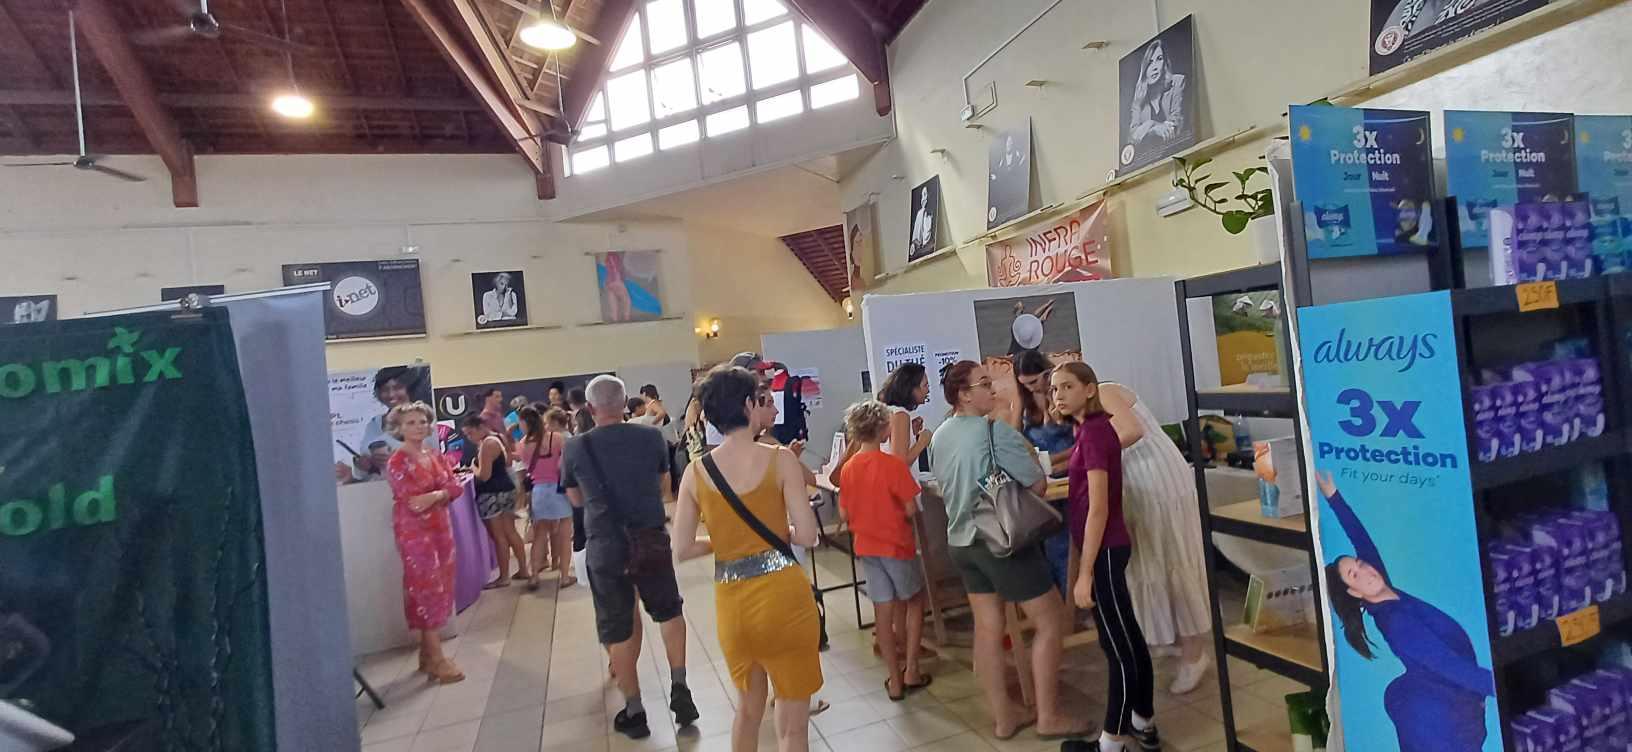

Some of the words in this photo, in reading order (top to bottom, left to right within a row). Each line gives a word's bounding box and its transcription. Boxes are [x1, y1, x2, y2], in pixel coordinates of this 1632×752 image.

[1352, 125, 1379, 149] 3x
[1501, 128, 1525, 149] 3x
[1330, 148, 1401, 166] Protection
[1480, 148, 1546, 163] Protection
[1027, 219, 1081, 257] INFRA
[1028, 240, 1099, 280] ROUGE
[1313, 326, 1438, 373] always
[445, 395, 466, 415] U
[1335, 388, 1426, 440] 3x
[1318, 441, 1458, 470] Protection
[1340, 467, 1360, 480] Fit
[1361, 471, 1395, 486] your
